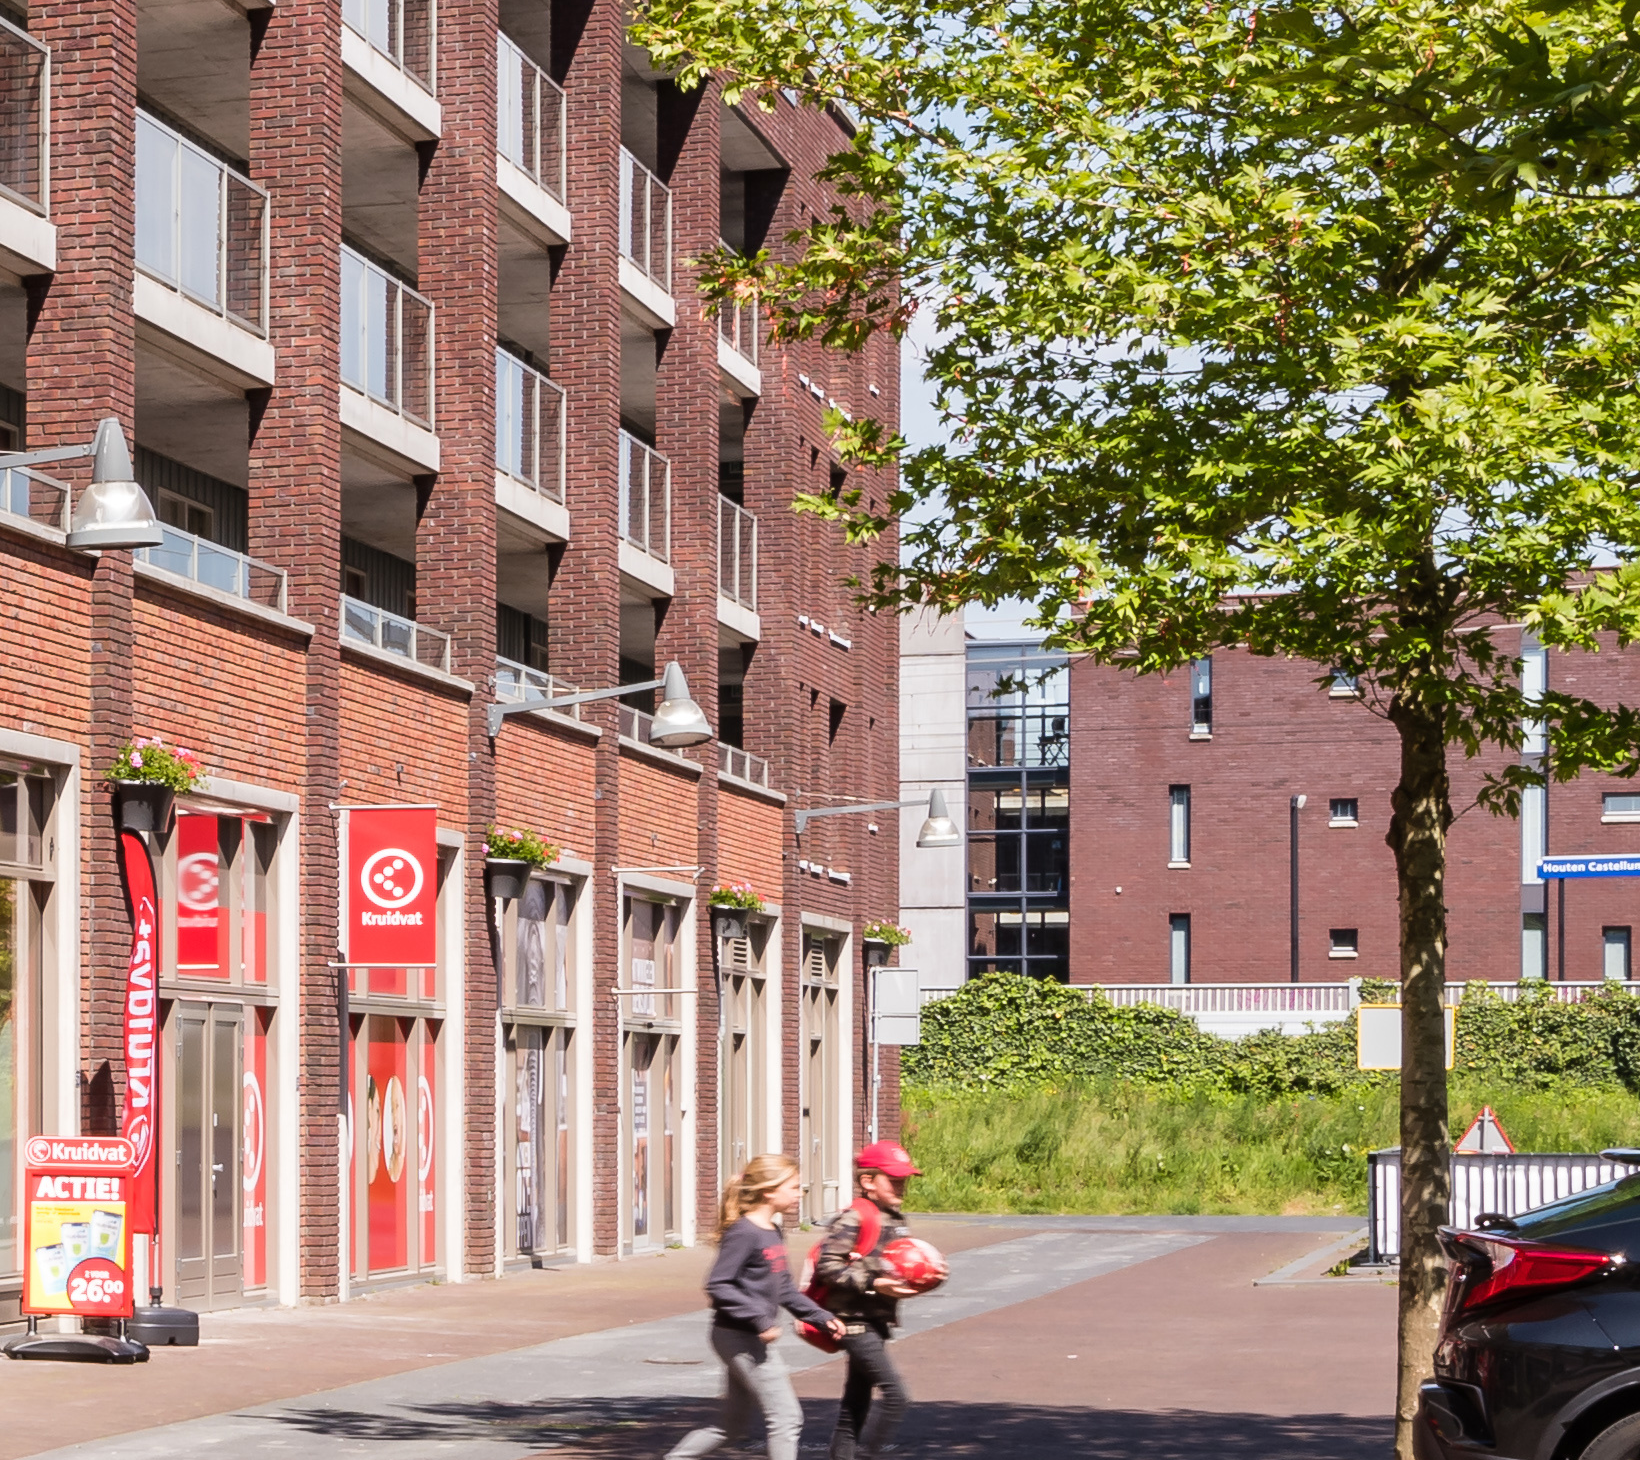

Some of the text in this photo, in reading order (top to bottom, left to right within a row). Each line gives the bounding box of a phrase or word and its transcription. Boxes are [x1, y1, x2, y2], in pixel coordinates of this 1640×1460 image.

[1543, 863, 1585, 873] Houten
[362, 911, 423, 926] Kruidvat
[52, 1143, 127, 1161] Kruidvat
[36, 1176, 119, 1201] ACTIE!
